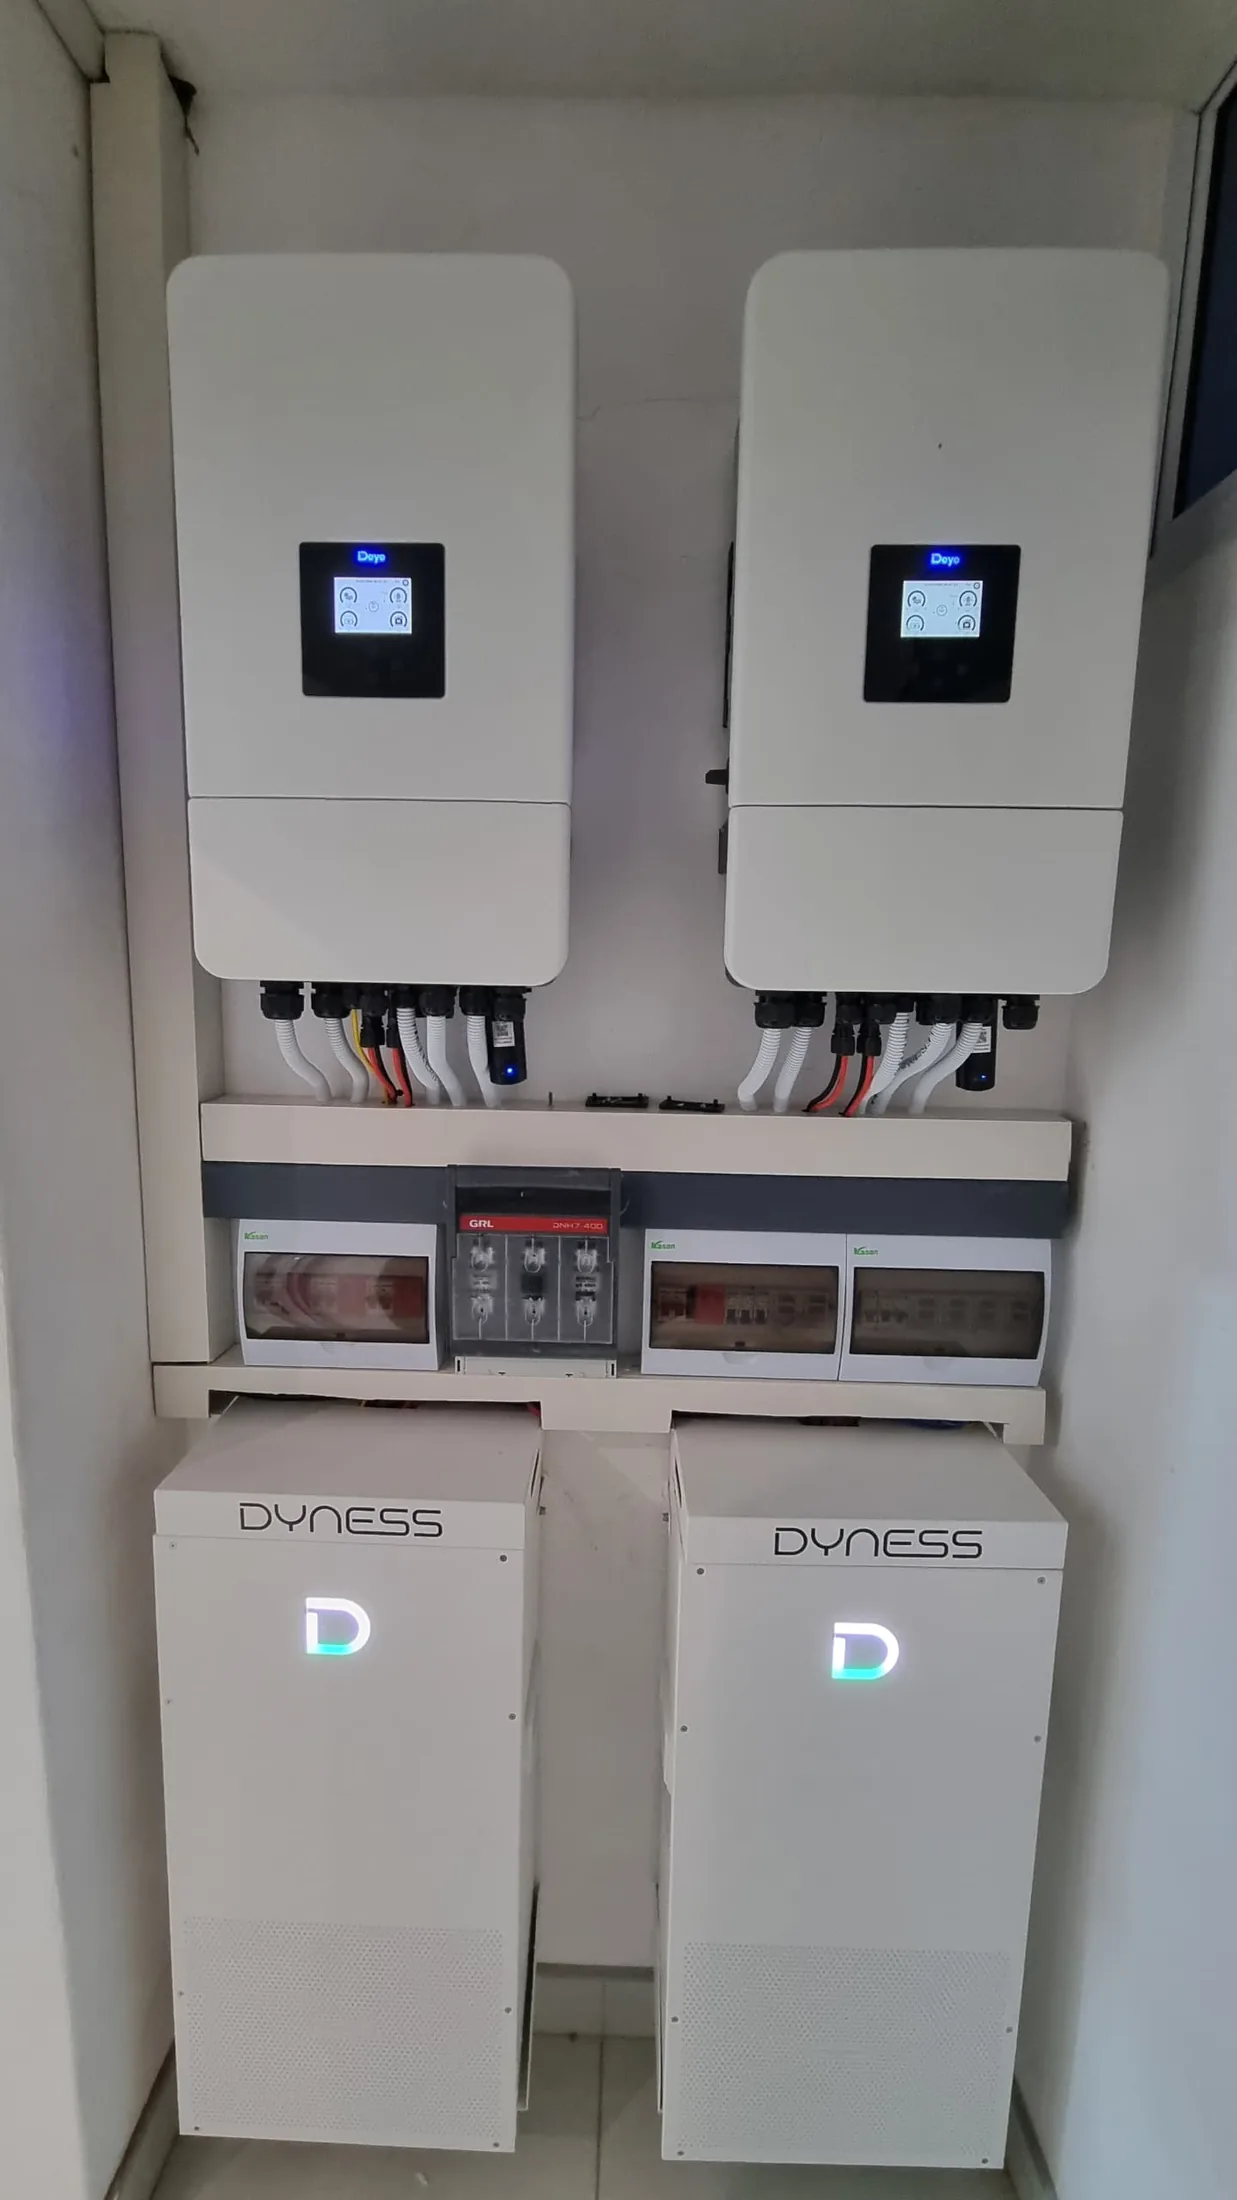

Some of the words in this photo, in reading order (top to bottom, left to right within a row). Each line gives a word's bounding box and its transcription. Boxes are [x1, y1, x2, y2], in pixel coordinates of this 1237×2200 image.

[469, 1219, 495, 1228] GRL
[239, 1502, 443, 1537] DYNESS
[774, 1527, 983, 1559] DYNESS
[305, 1596, 371, 1656] D
[831, 1622, 900, 1681] D
